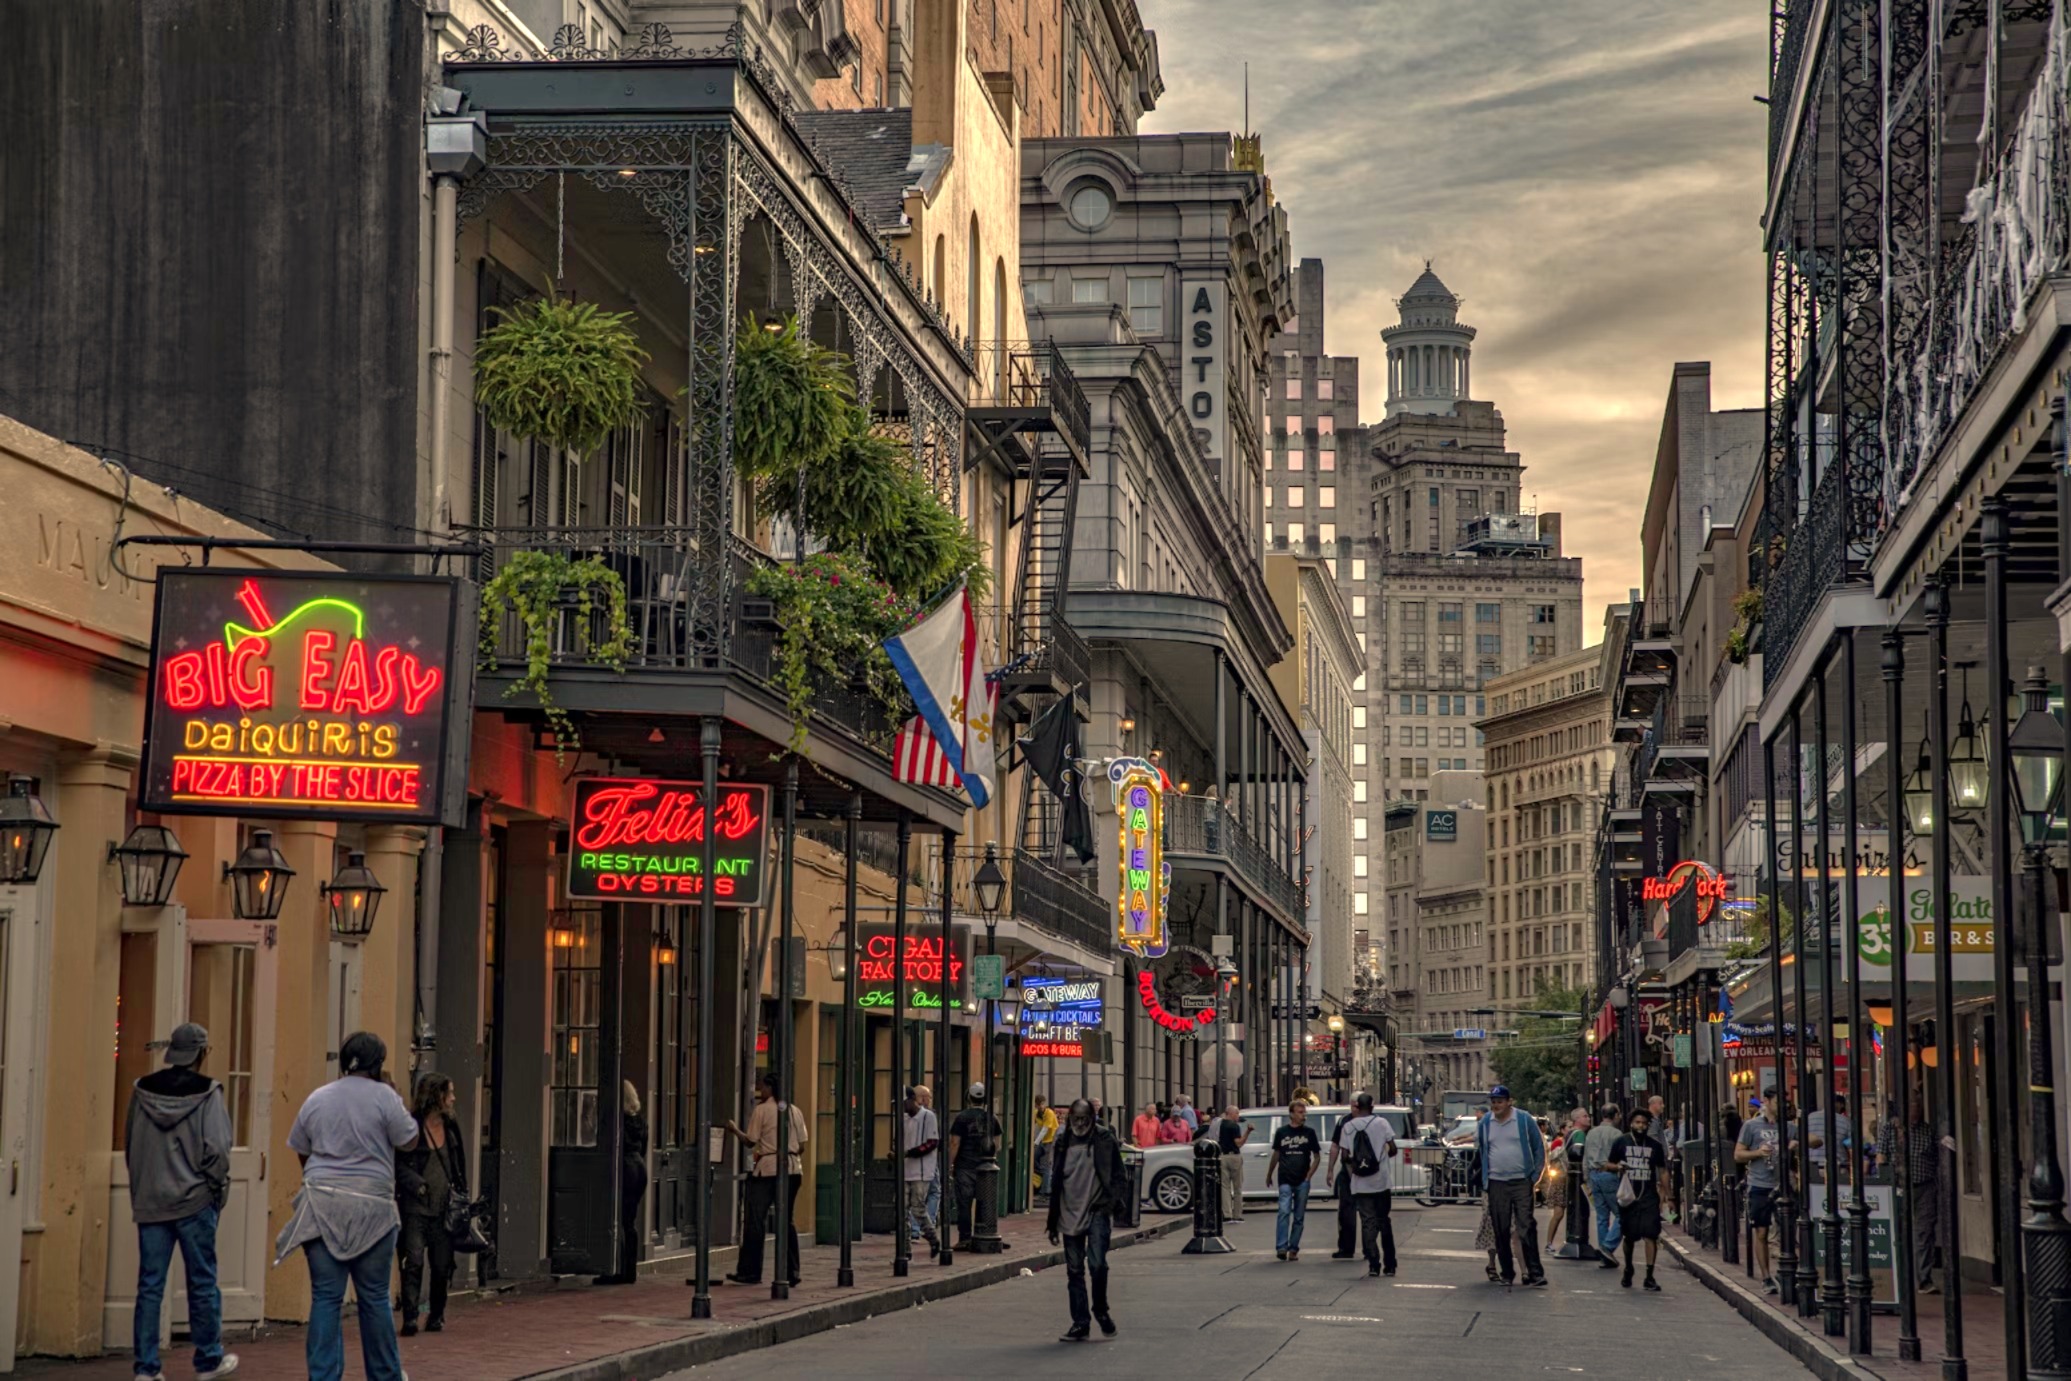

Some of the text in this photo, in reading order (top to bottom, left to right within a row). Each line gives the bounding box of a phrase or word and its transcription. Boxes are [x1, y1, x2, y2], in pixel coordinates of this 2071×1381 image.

[1191, 286, 1213, 455] ASTOR
[37, 513, 147, 602] MAUM
[165, 629, 442, 716] BIG EASY
[172, 759, 420, 804] PIZZA BY THE SLICE
[577, 782, 761, 850] Felix's
[1430, 813, 1455, 827] AC
[1655, 806, 1664, 832] ATT
[580, 853, 754, 876] RESTAURNT
[1129, 786, 1151, 933] GATEWAY
[1641, 872, 1727, 900] Hard ock
[1923, 931, 1963, 945] BR
[1967, 931, 1982, 945] &
[1023, 983, 1100, 1005] GATEWAY
[1138, 971, 1195, 1032] BOURBON
[1055, 1009, 1101, 1024] COCKTAILS
[1065, 1026, 1098, 1041] BE
[1164, 1028, 1200, 1042] SEAFOO
[1461, 1030, 1480, 1039] Canal
[1742, 1037, 1795, 1047] AUTHEIC
[1050, 1043, 1061, 1055] &
[1059, 1045, 1083, 1056] BURR
[1722, 1047, 1822, 1058] EW ORLEAN CUINE
